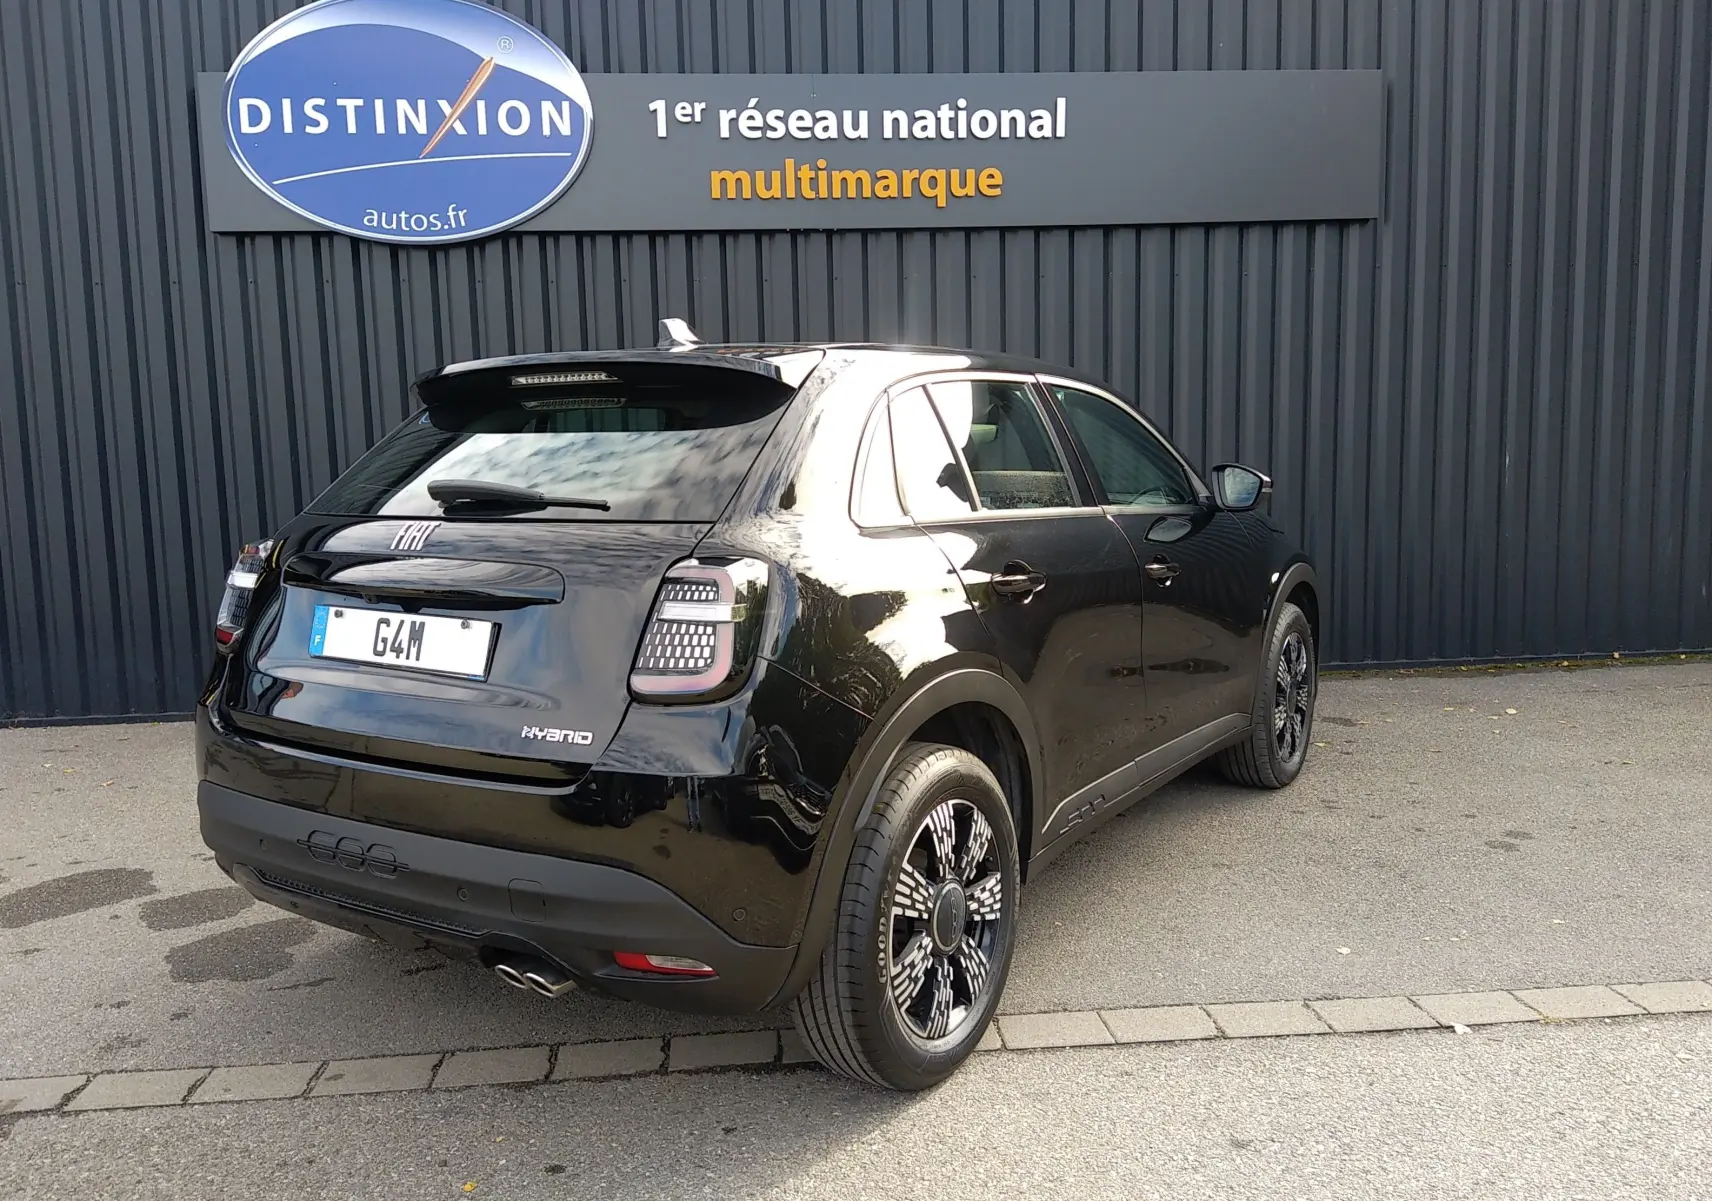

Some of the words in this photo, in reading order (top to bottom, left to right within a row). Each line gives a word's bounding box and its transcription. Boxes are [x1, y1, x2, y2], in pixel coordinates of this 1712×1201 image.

[238, 97, 572, 136] DISTINXION
[648, 98, 707, 138] 1er
[719, 97, 869, 139] réseau
[883, 97, 1067, 139] national
[710, 158, 1003, 207] multimarque
[362, 203, 469, 232] autos.fr
[390, 521, 441, 551] FIAT
[314, 634, 321, 646] F
[372, 617, 426, 662] G4M
[520, 725, 593, 745] HYBRID
